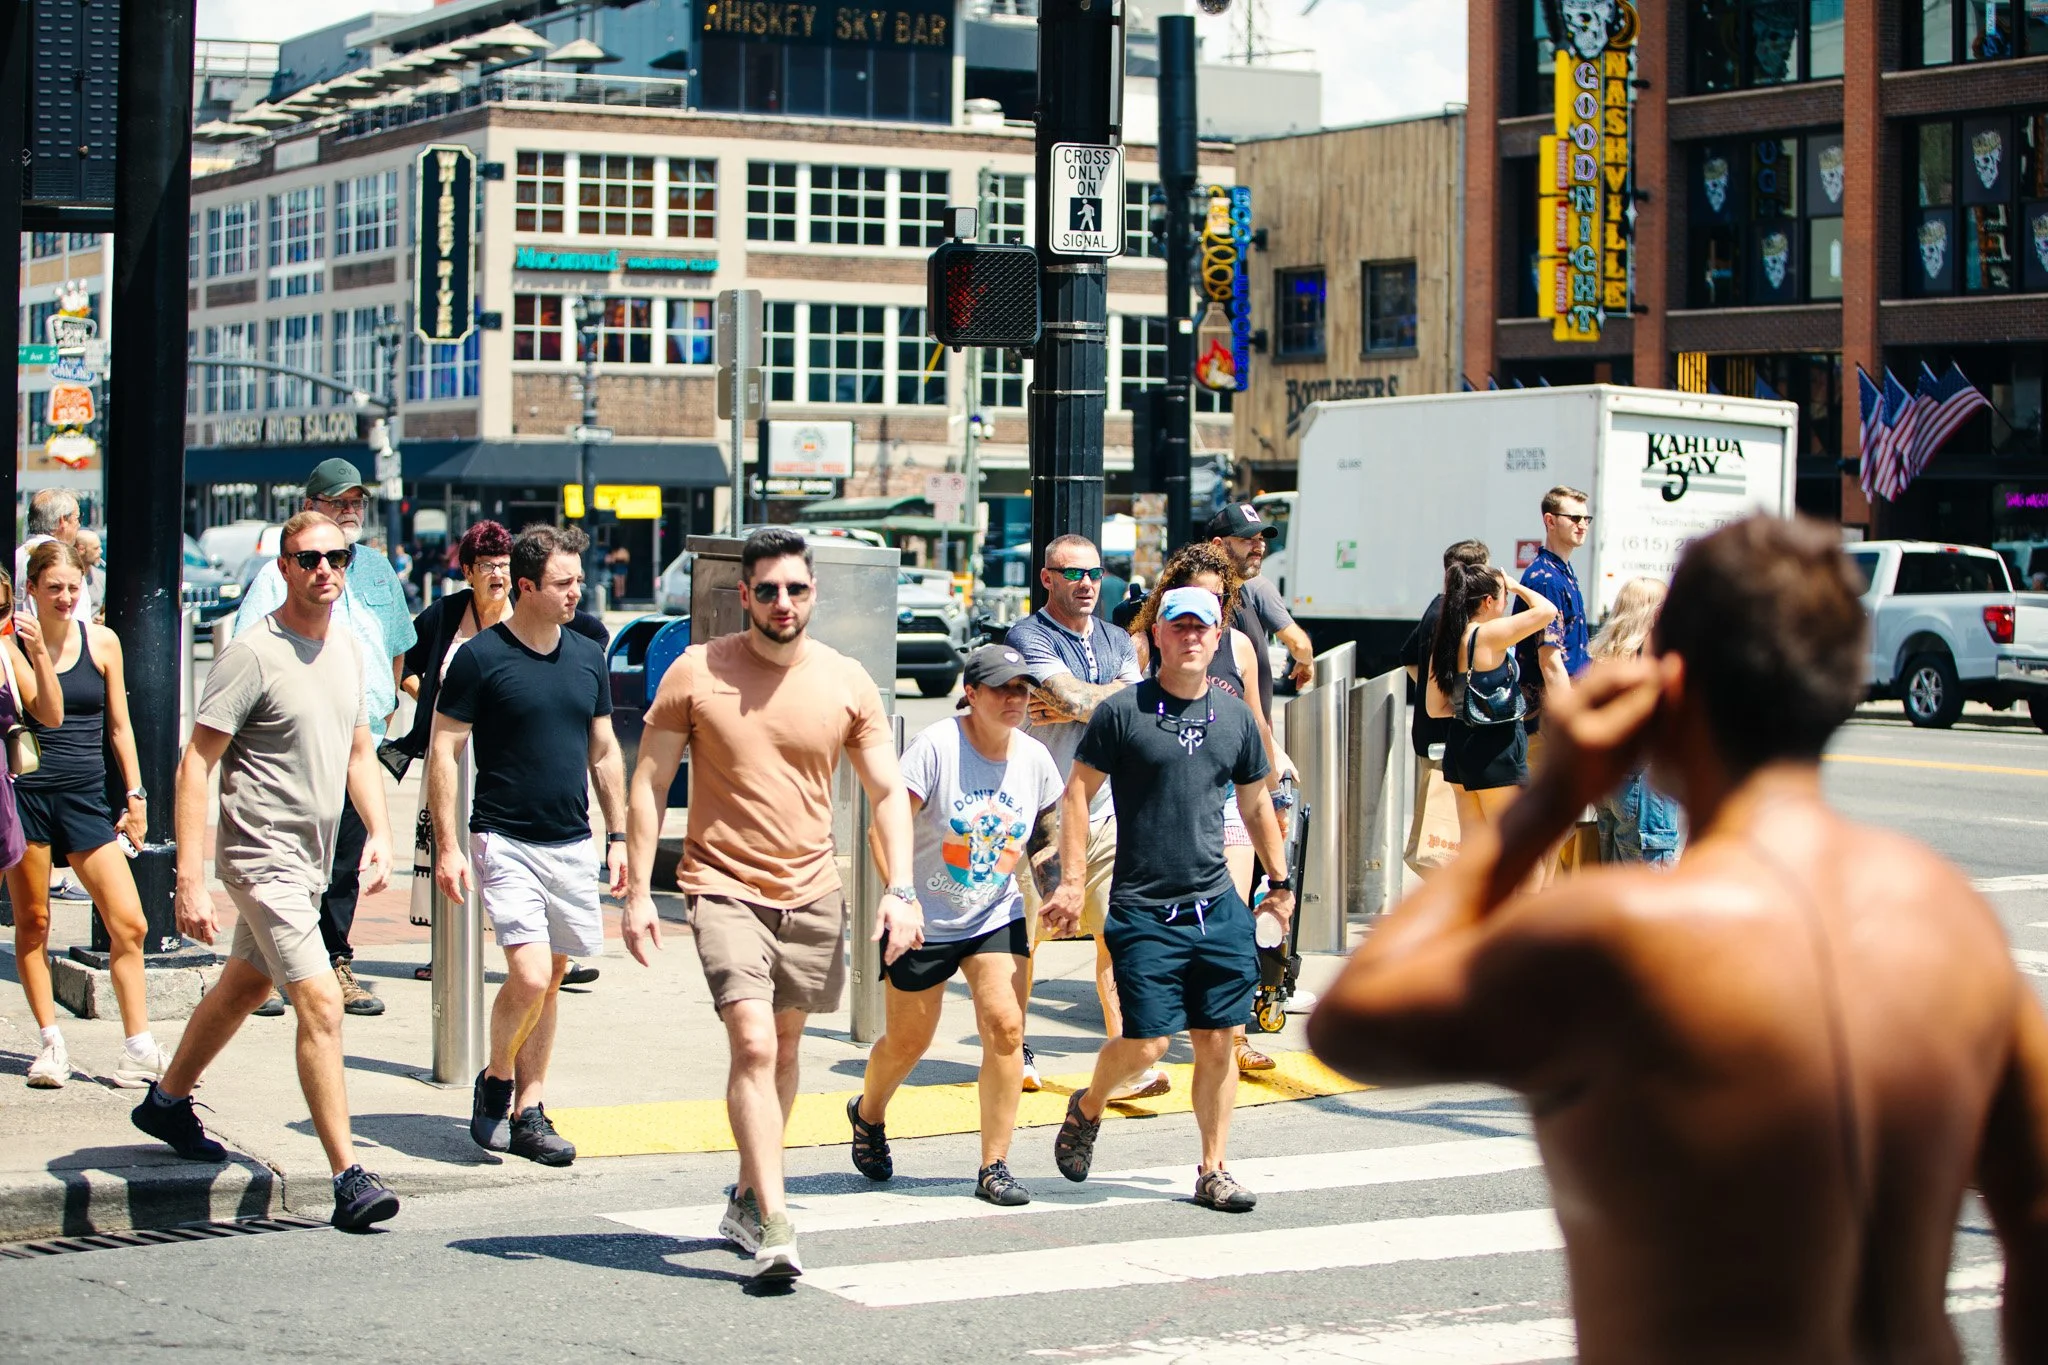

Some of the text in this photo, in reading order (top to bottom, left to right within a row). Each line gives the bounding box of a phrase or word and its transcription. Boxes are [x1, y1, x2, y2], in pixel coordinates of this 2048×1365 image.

[704, 0, 947, 46] WHISKEY SKY BAR
[1064, 149, 1111, 165] CROSS
[1068, 165, 1105, 181] ONLY
[1077, 181, 1096, 196] ON
[1605, 51, 1627, 308] NASHVILLE
[1574, 62, 1599, 333] GOODNIGHT
[436, 151, 459, 338] WHISKEY RIVER
[1062, 233, 1108, 248] SIGNAL
[1231, 187, 1252, 391] BOOTLEGGERS
[214, 409, 358, 444] WHISKEY RIVER SALOON
[1648, 432, 1746, 468] KAHLUA
[1662, 455, 1719, 502] BAY
[1622, 535, 1669, 551] (615)
[954, 789, 1023, 816] DON'T BE A
